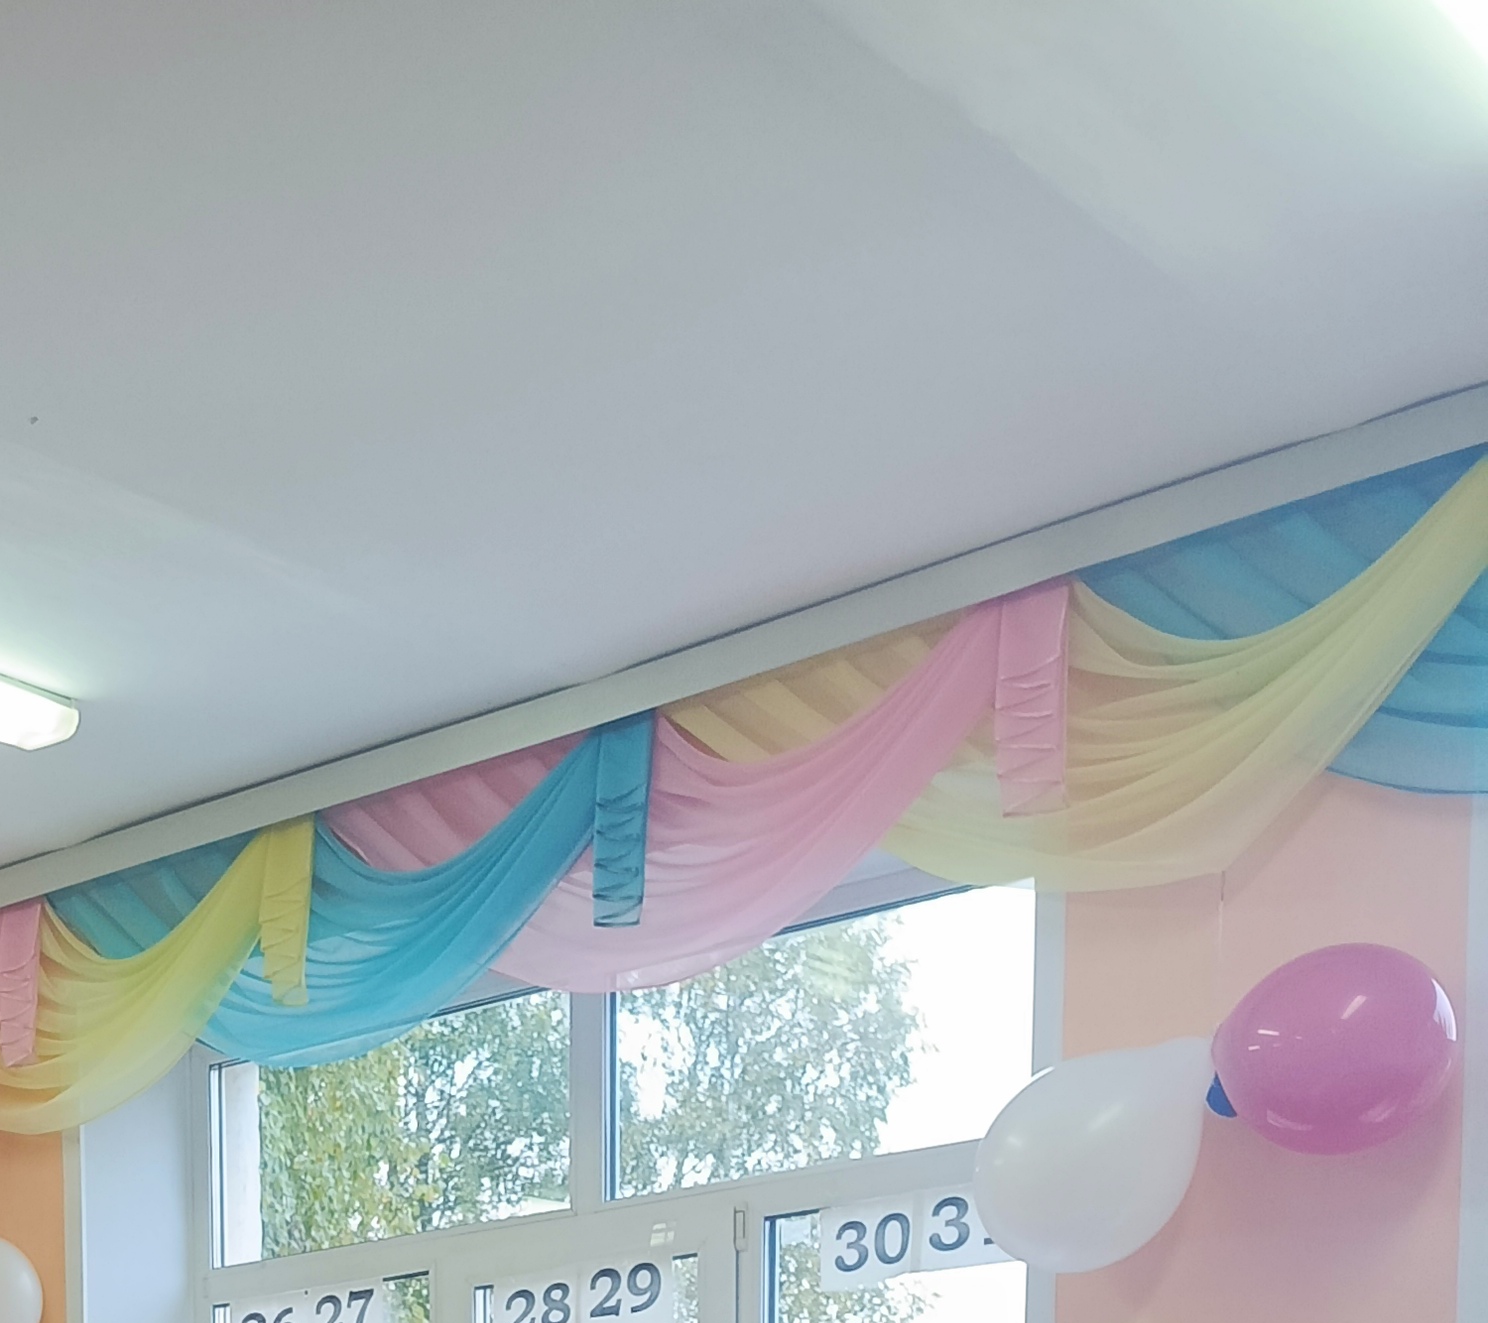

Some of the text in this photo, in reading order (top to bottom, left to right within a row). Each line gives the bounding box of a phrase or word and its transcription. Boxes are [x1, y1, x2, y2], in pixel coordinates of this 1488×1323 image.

[834, 1212, 910, 1273] 30
[928, 1196, 995, 1252] 3
[590, 1262, 662, 1319] 29
